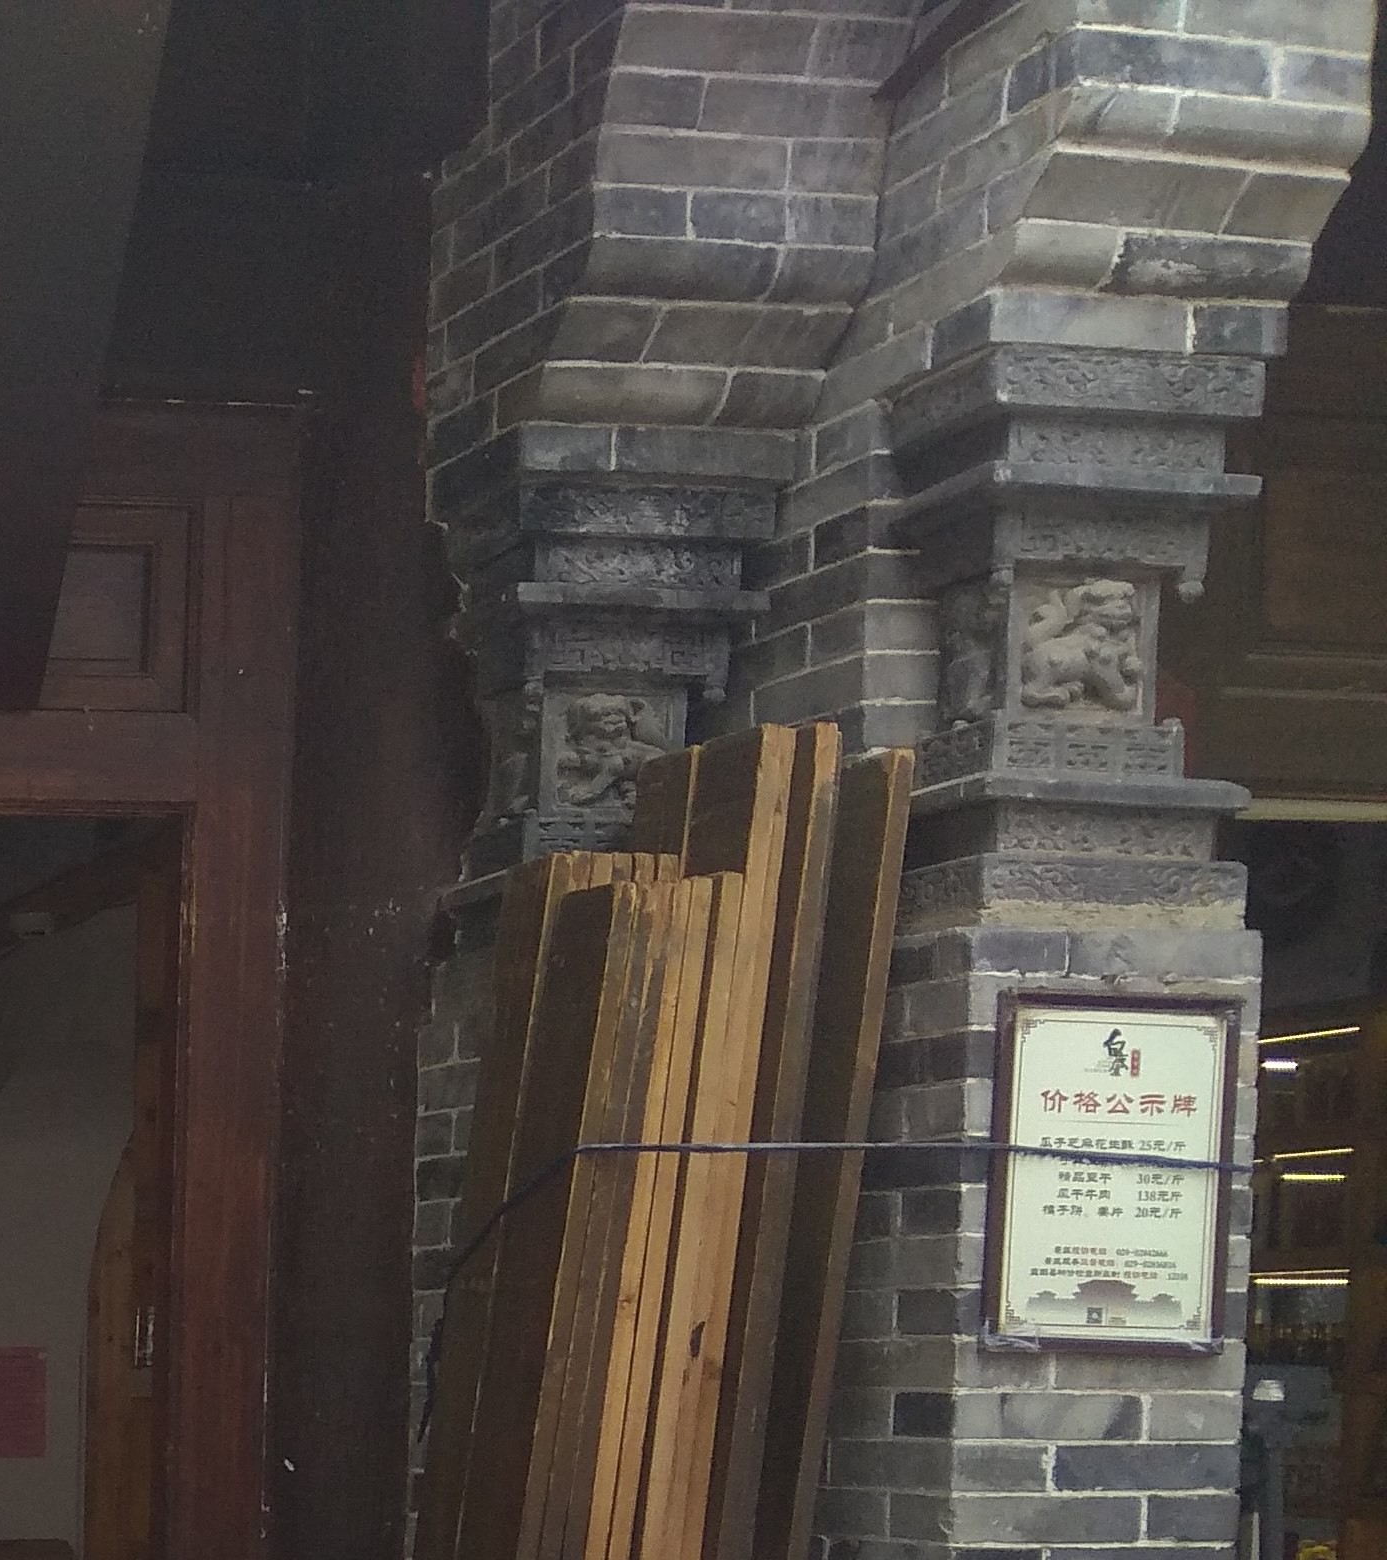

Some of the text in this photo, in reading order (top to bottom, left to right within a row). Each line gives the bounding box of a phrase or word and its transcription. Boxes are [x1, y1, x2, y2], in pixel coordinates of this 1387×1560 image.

[1040, 1088, 1198, 1118] 价格公示牌
[1139, 1139, 1187, 1152] 25元/斤
[1136, 1173, 1185, 1186] 30元/斤
[1134, 1206, 1183, 1219] 20元/斤
